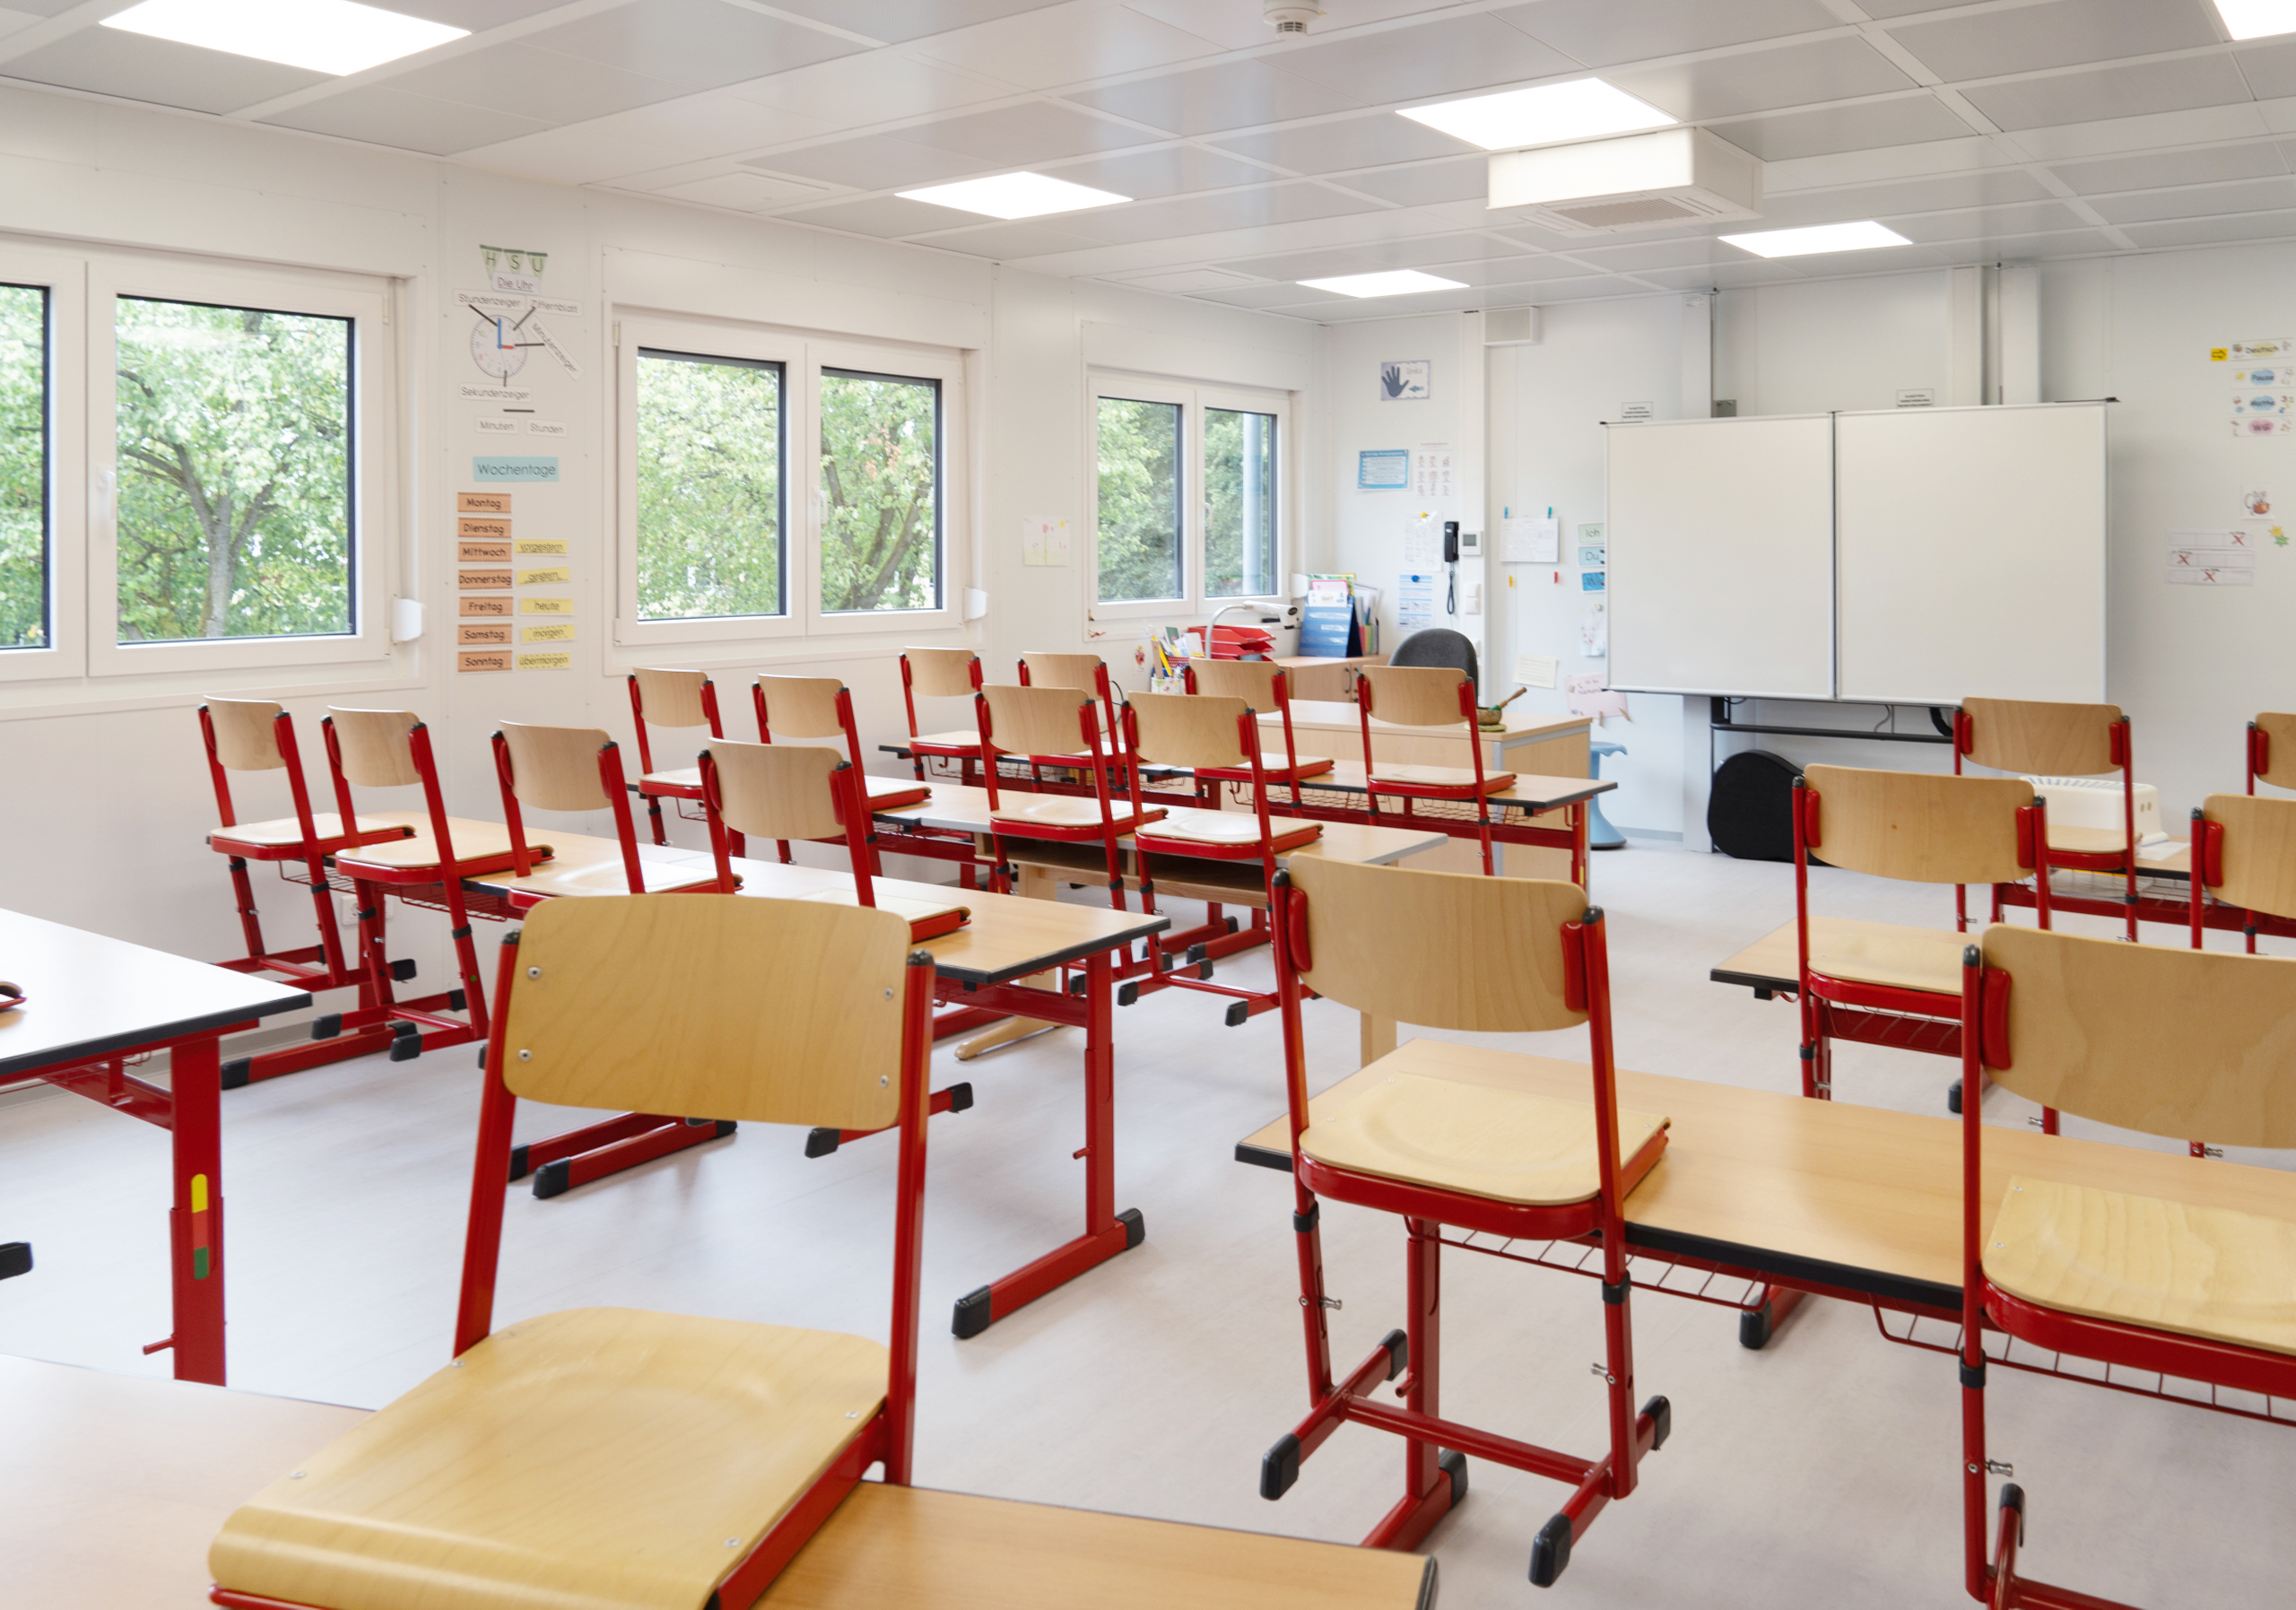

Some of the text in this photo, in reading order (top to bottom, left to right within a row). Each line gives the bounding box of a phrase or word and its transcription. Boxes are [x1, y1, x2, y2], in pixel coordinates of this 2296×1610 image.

[497, 276, 534, 290] Die Uhr
[458, 293, 521, 308] Stundenzeiger
[532, 322, 578, 372] Minutenzeiger
[461, 387, 530, 400] Sekundenzeiger
[480, 421, 515, 431] Minuten
[530, 422, 564, 433] Stunden
[477, 464, 556, 478] Wochentage
[466, 498, 501, 510] Montag
[463, 523, 504, 535] Dienstag
[1585, 528, 1601, 538] Ich
[462, 547, 506, 557] Mittwoch
[519, 543, 563, 553] vorgestern
[1585, 551, 1600, 561] Du
[458, 575, 512, 586] Donnerstag
[527, 571, 559, 584] gestern
[468, 602, 503, 614] Freitag
[534, 601, 560, 611] heute
[465, 630, 505, 641] Samstag
[533, 629, 564, 640] morgen
[465, 657, 504, 668] Sonntag
[519, 656, 569, 667] übermorgen
